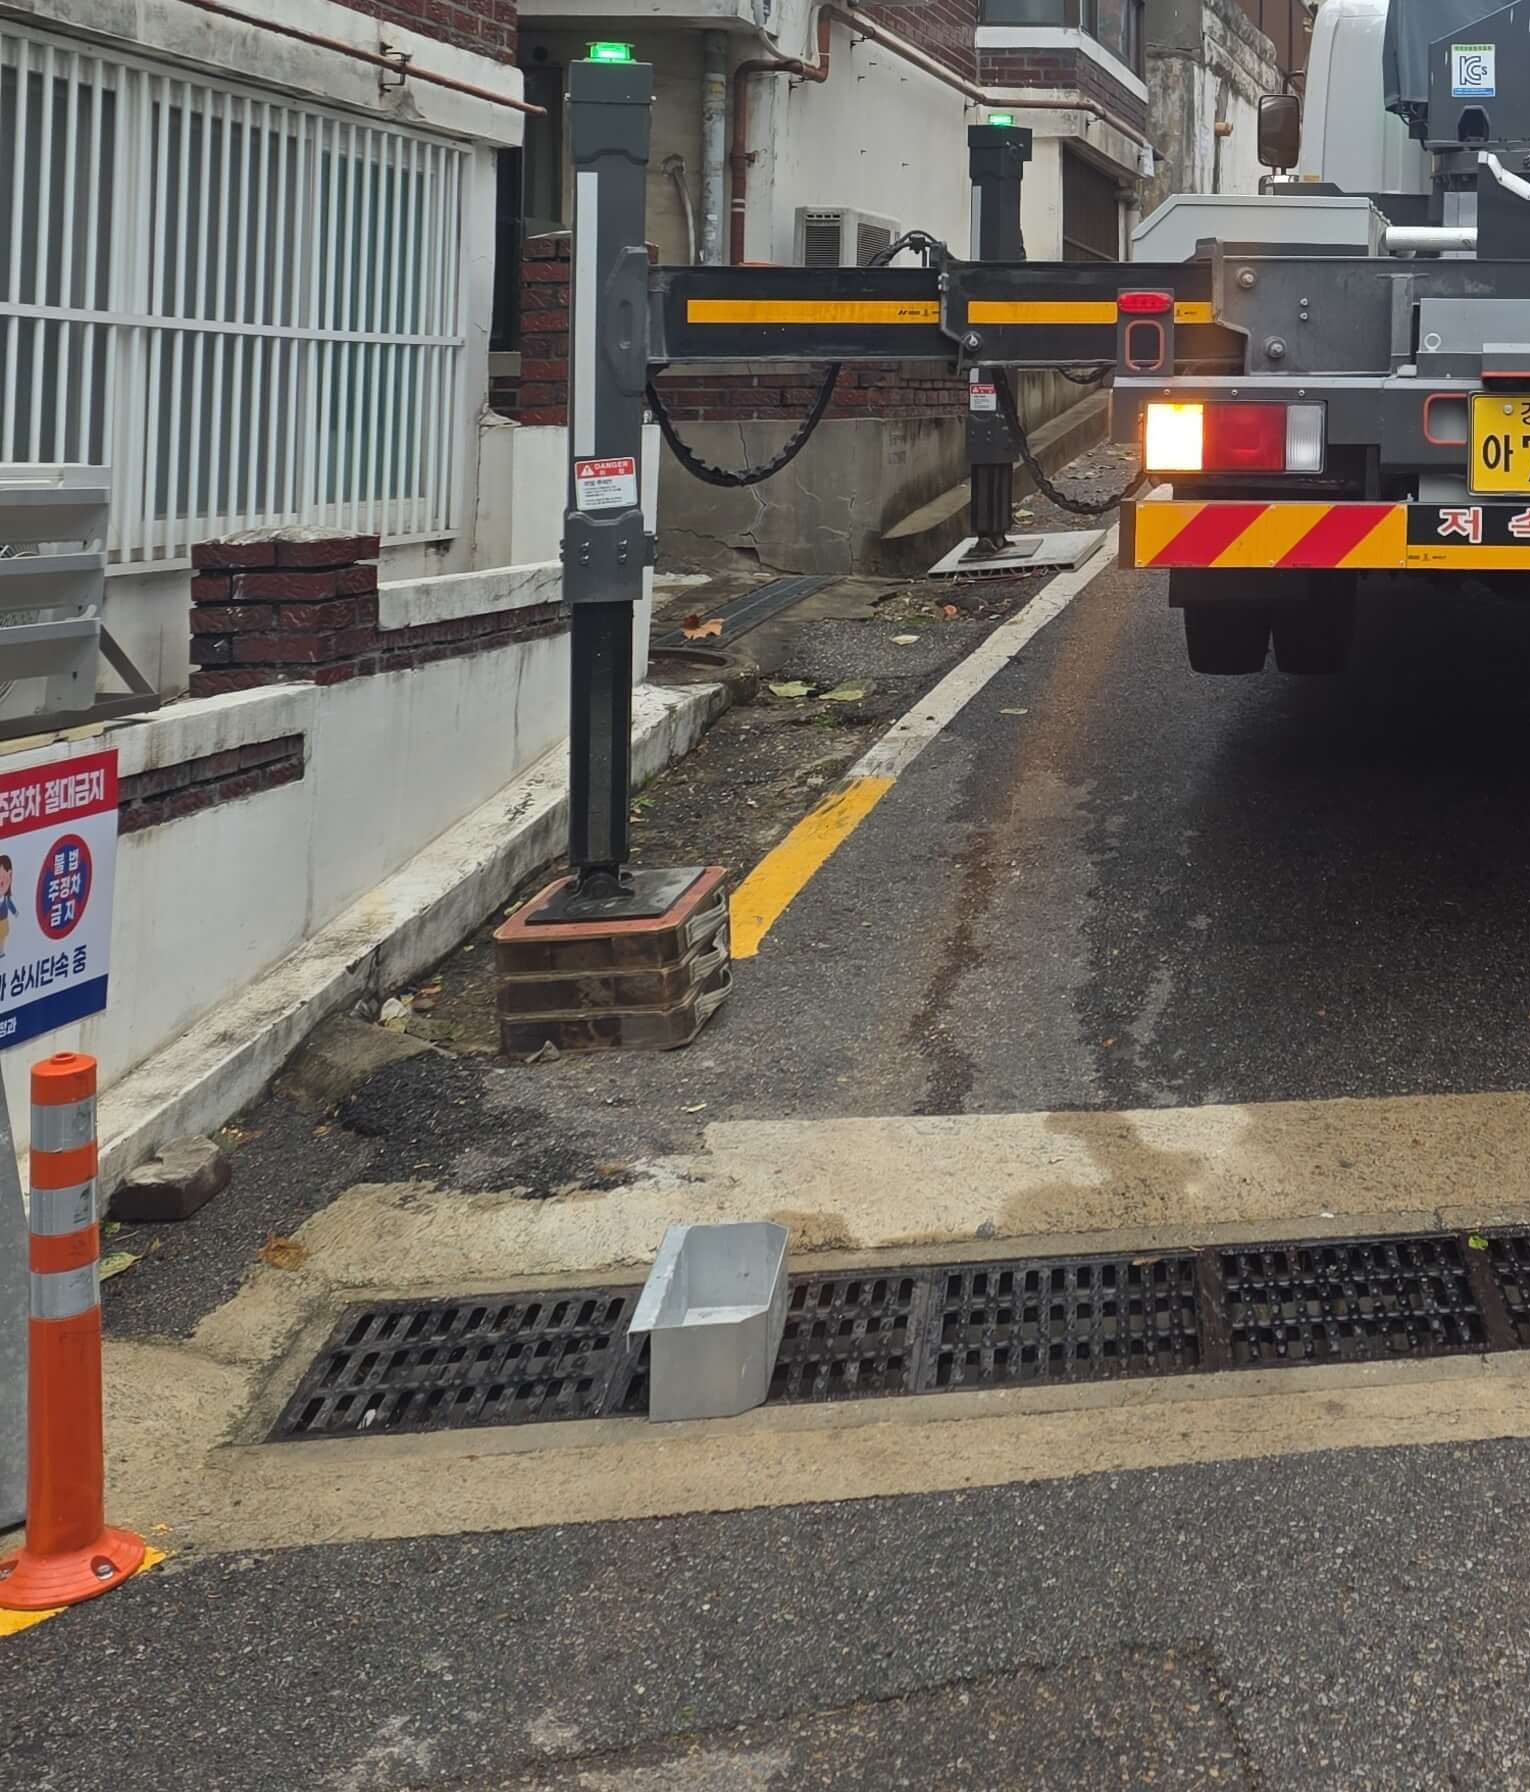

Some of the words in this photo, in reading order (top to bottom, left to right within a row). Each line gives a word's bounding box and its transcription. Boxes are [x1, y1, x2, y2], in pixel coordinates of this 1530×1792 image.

[594, 460, 629, 470] DANGER
[45, 769, 104, 815] 절대금지
[48, 873, 81, 901] 주정차
[11, 952, 69, 997] 상시단속
[73, 945, 87, 974] 중
